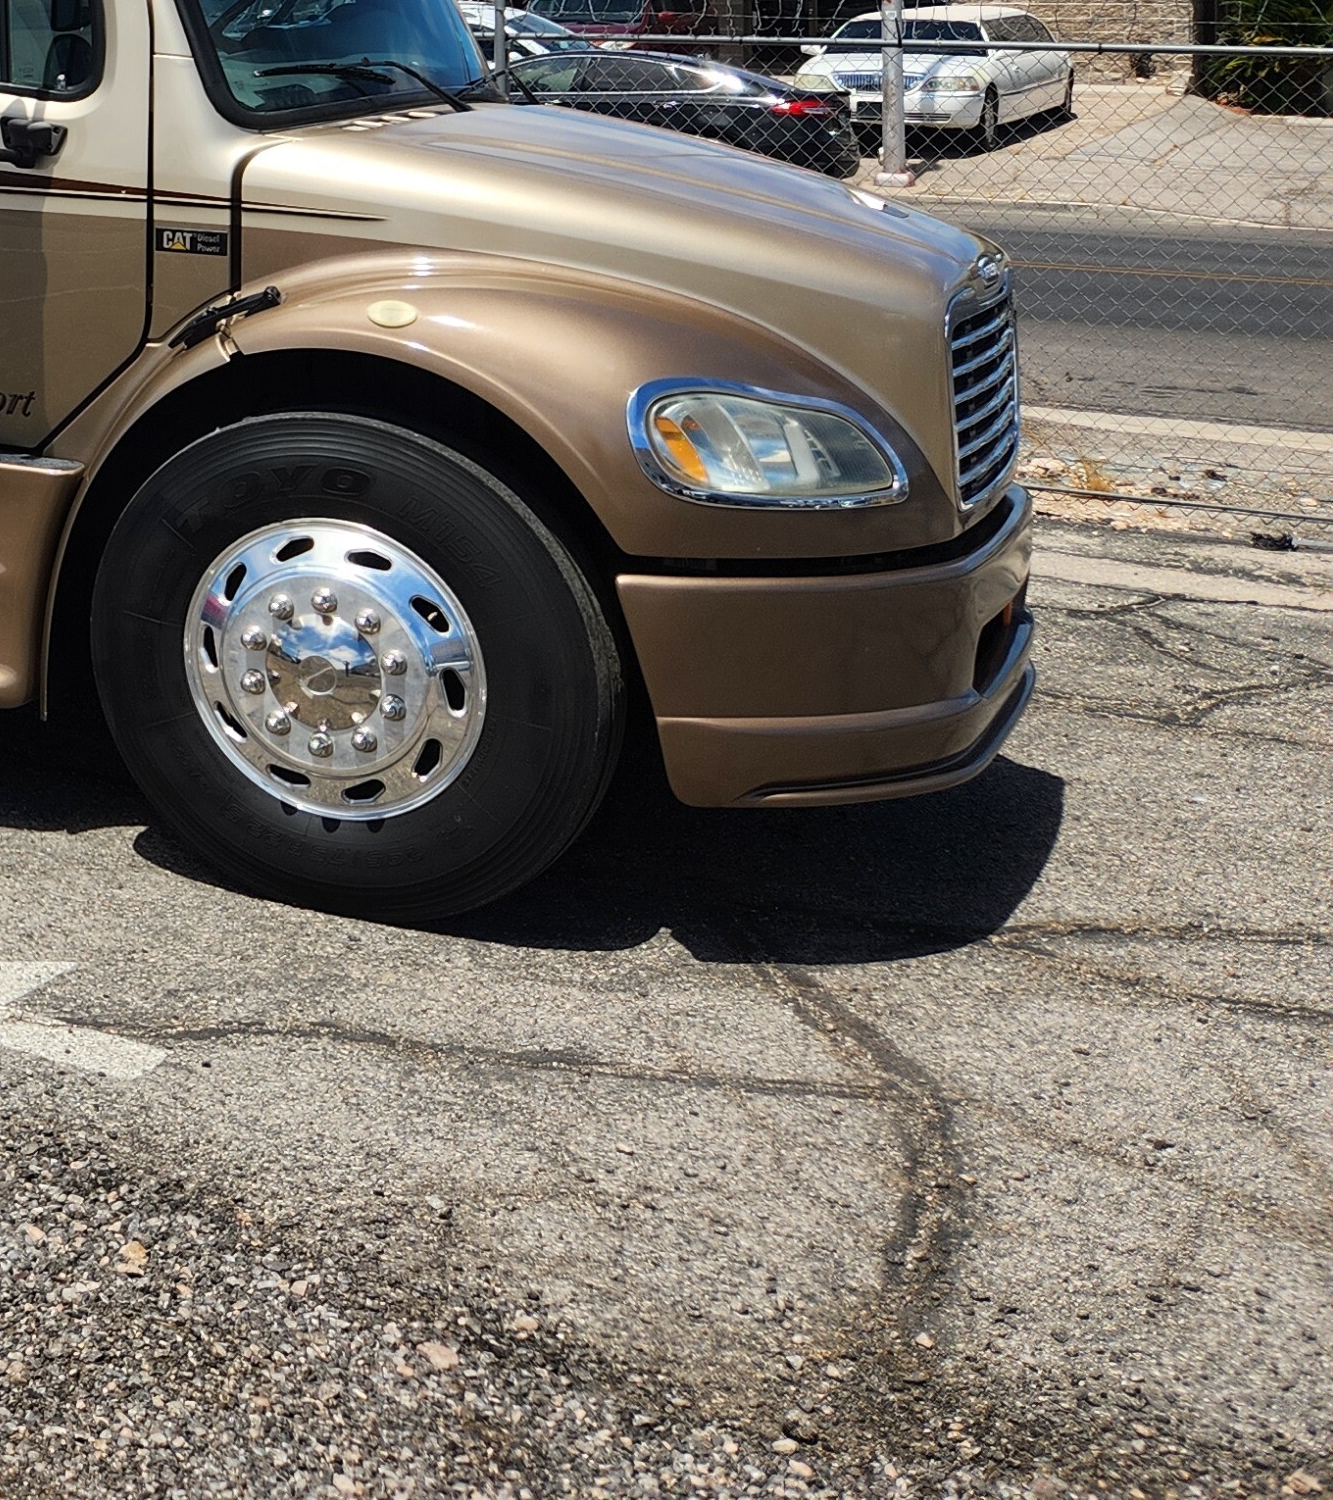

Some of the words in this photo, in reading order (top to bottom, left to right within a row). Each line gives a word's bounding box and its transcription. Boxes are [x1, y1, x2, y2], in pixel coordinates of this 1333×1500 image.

[162, 230, 193, 252] CAT
[197, 233, 220, 243] Diesel
[197, 243, 221, 253] Power
[175, 463, 372, 532] TOYO
[399, 496, 505, 588] M154
